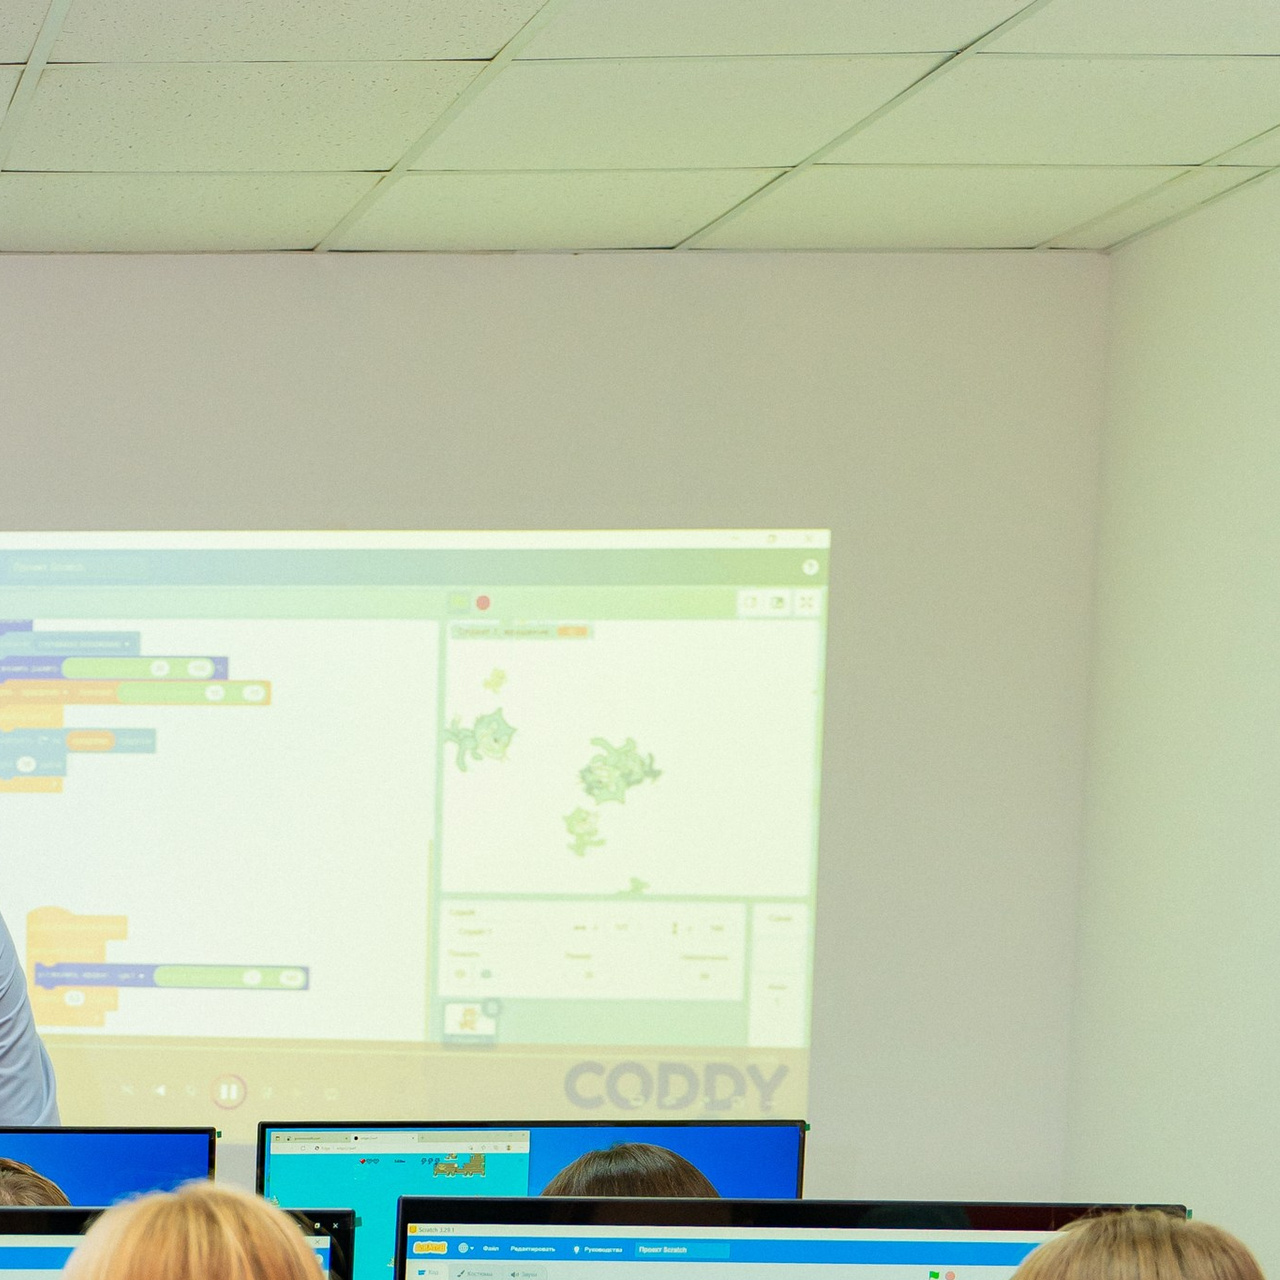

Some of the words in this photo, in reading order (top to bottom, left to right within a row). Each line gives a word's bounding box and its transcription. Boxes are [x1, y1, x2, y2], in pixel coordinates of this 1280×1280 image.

[563, 1060, 791, 1112] CODDY
[510, 1245, 556, 1253] Редактировать
[638, 1246, 662, 1255] Проект
[663, 1246, 688, 1254] Scratch
